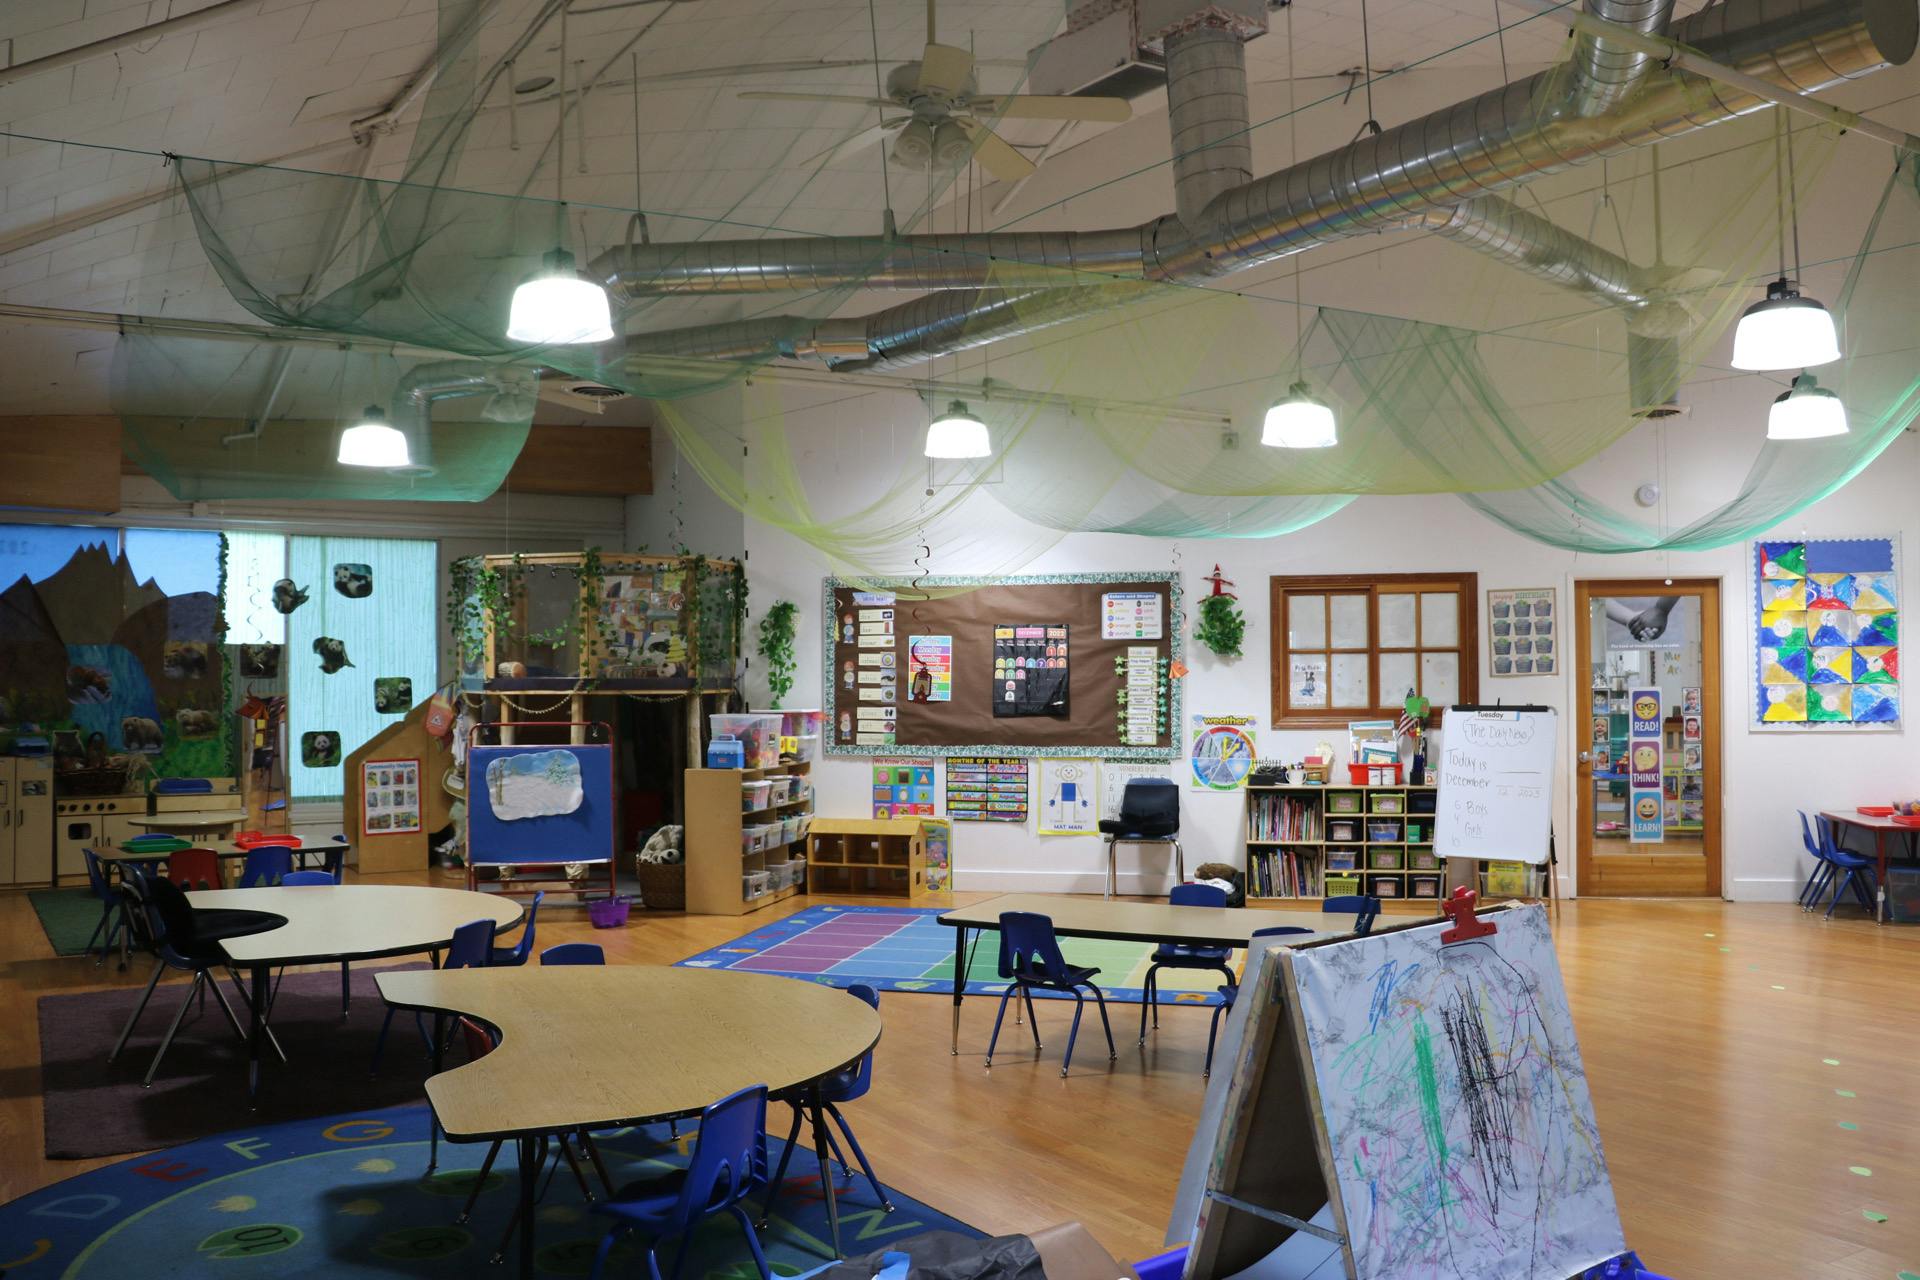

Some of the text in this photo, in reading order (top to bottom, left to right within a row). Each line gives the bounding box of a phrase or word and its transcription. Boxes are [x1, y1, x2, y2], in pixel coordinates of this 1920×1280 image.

[1203, 716, 1248, 725] weather
[1477, 711, 1504, 719] Tuesday
[1467, 723, 1486, 738] The
[1634, 721, 1659, 732] READ!
[1446, 748, 1477, 772] Today
[1445, 773, 1489, 788] December
[1632, 773, 1659, 783] THINK!
[1634, 823, 1660, 833] LEARN!
[322, 1120, 395, 1142] G
[224, 1137, 272, 1160] F
[131, 1156, 209, 1183] E
[29, 1193, 121, 1220] D
